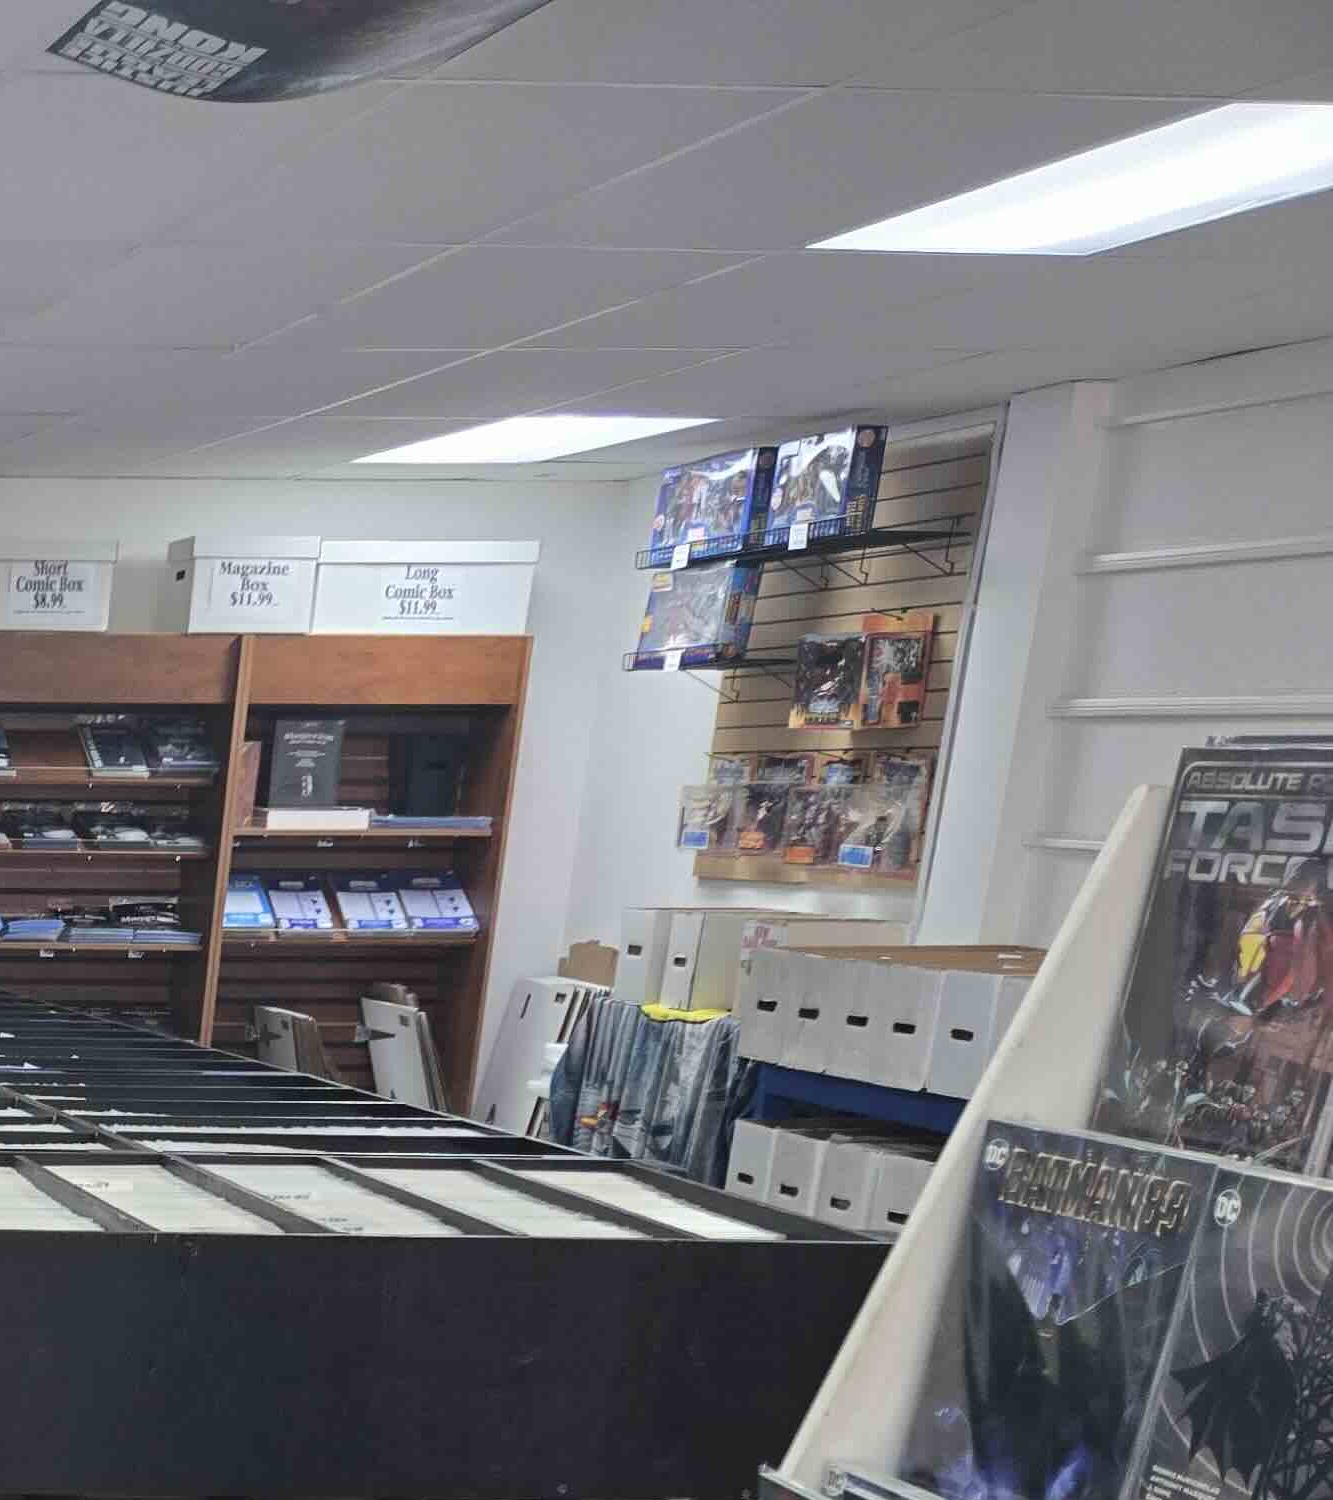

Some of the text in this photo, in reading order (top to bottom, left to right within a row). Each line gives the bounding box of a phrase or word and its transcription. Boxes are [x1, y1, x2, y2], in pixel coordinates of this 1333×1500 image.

[99, 0, 270, 65] KONG
[33, 560, 69, 576] Short
[220, 562, 290, 577] Magazine
[405, 566, 440, 583] Long
[16, 576, 84, 593] Comic Box
[239, 577, 269, 591] Box
[384, 584, 455, 600] Comic Box
[1188, 770, 1304, 792] ABSOLUTE
[1179, 799, 1333, 855] TAS
[1214, 1192, 1242, 1222] DC
